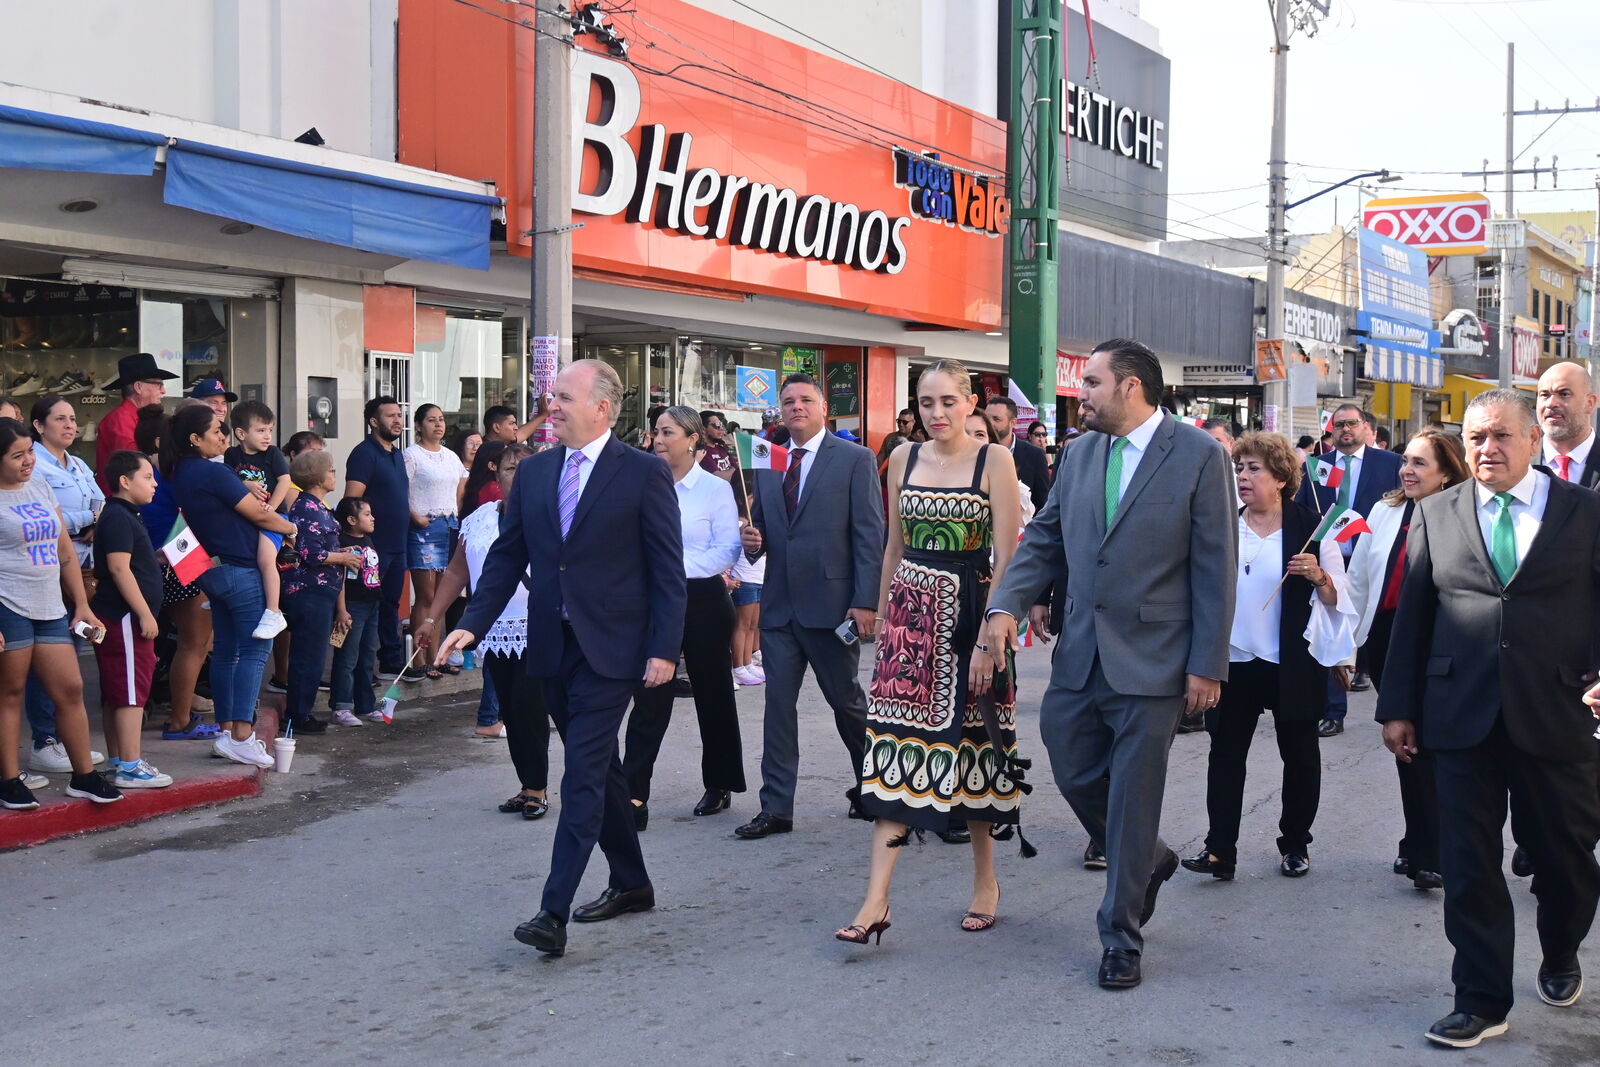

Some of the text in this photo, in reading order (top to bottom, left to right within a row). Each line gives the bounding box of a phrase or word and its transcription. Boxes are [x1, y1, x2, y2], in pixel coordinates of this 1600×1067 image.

[1060, 78, 1165, 172] ERTICHE
[571, 46, 912, 275] B Hermanos
[894, 147, 952, 193] Todo
[911, 188, 954, 222] con
[953, 170, 1011, 236] Vale
[1368, 206, 1483, 244] OXXO
[1284, 301, 1341, 344] ERRETODO
[1516, 332, 1539, 376] OXXO
[81, 395, 107, 404] adidas
[9, 502, 50, 519] YES
[22, 519, 58, 543] GIRL
[26, 543, 58, 566] YES
